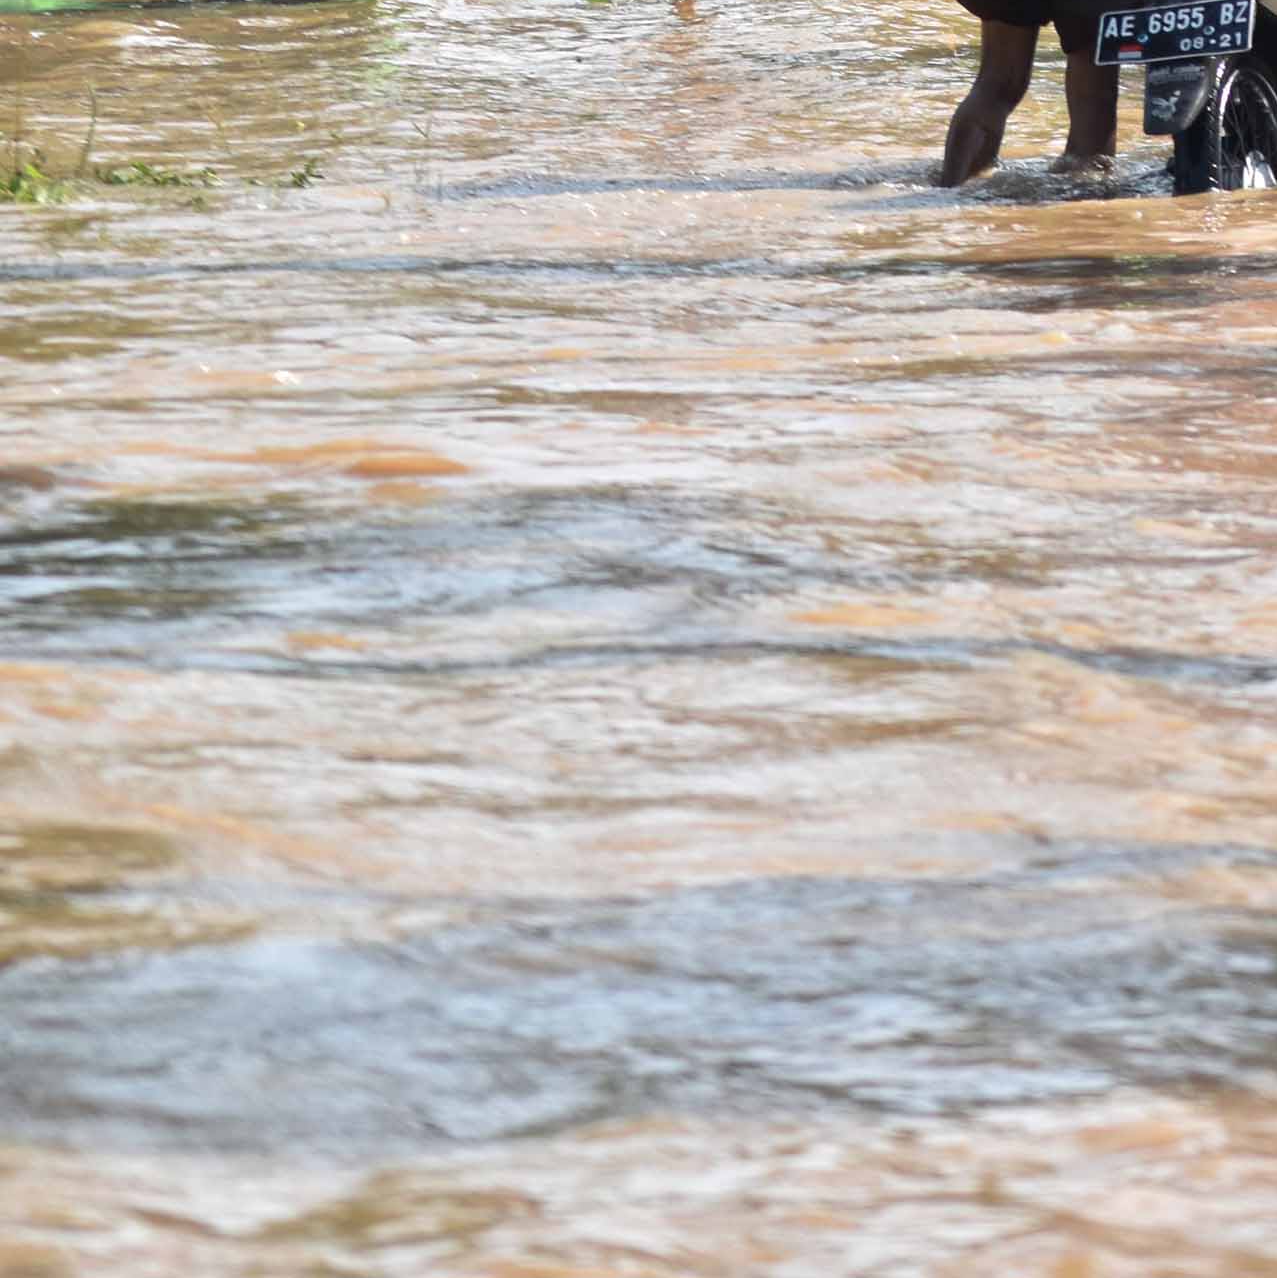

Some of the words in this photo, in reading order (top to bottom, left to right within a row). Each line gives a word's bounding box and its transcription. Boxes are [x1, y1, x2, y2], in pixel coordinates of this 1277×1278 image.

[1104, 16, 1136, 38] AE
[1148, 7, 1206, 35] 6955
[1220, 1, 1249, 26] BZ
